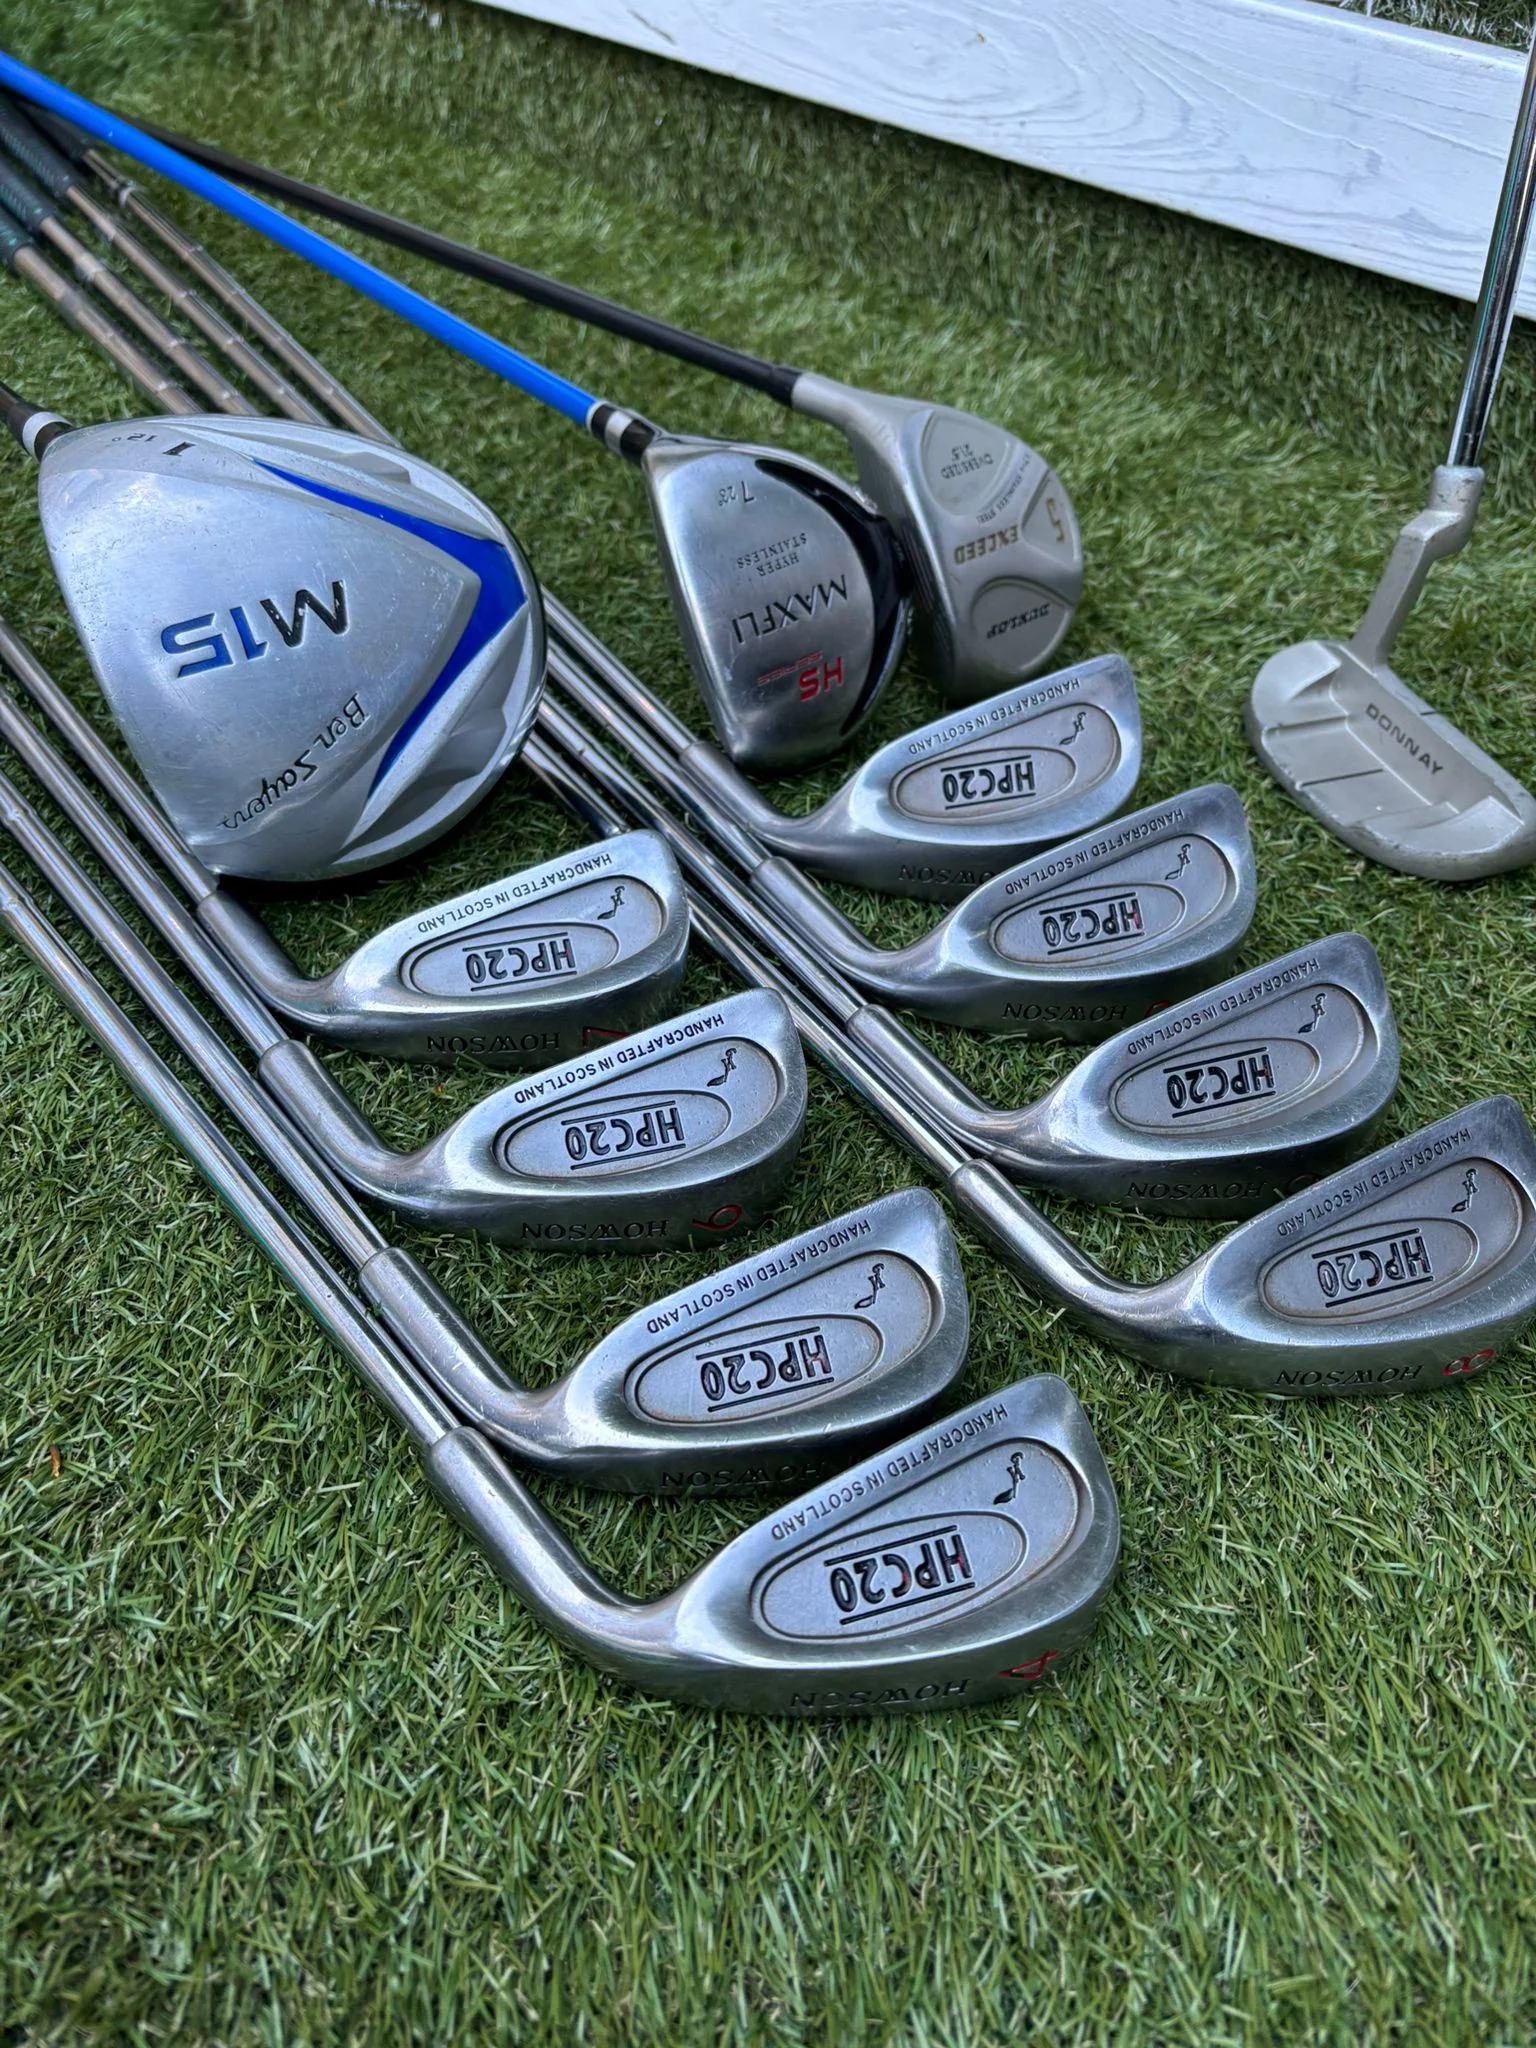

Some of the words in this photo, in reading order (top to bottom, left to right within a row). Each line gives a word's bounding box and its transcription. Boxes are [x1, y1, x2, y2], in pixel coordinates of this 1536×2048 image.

[162, 441, 197, 457] 1
[741, 480, 755, 503] 7
[1046, 498, 1065, 543] 5
[736, 533, 807, 569] STAINLESS
[756, 552, 799, 577] HYPER
[953, 523, 1020, 565] EXCEED
[160, 579, 349, 679] M15
[731, 574, 848, 644] MAXFLI
[986, 603, 1050, 639] DUNLOP
[798, 656, 844, 702] HS
[991, 678, 1081, 721] HANDCRAFTED
[314, 693, 371, 751] Ben
[908, 719, 975, 755] SCOTLAND
[976, 714, 990, 727] IN
[1365, 703, 1444, 775] DONNAY
[217, 749, 320, 829] Sayers
[942, 761, 1036, 802] HPC20
[1092, 808, 1185, 857] HANDCRAFTED
[513, 853, 613, 898] HANDCRAFTED
[1005, 854, 1074, 895] SCOTLAND
[1075, 849, 1090, 864] IN
[417, 895, 494, 933] SCOTLAND
[495, 891, 511, 905] IN
[1042, 899, 1144, 947] HPC20
[466, 938, 576, 984] HPC20
[1220, 958, 1321, 1012] HANDCRAFTED
[1001, 1002, 1128, 1022] HOWSON
[1203, 1003, 1218, 1019] IN
[427, 1033, 560, 1052] HOWSON
[617, 1014, 725, 1063] HANDCRAFTED
[1127, 1012, 1201, 1055] SCOTLAND
[514, 1064, 597, 1104] SCOTLAND
[598, 1058, 615, 1073] IN
[1167, 1054, 1276, 1109] HPC20
[565, 1107, 685, 1161] HPC20
[1372, 1128, 1472, 1187] HANDCRAFTED
[1124, 1181, 1264, 1200] HOWSON
[1353, 1180, 1369, 1196] IN
[520, 1220, 668, 1241] HOWSON
[1277, 1187, 1354, 1236] SCOTLAND
[758, 1219, 872, 1282] HANDCRAFTED
[1317, 1236, 1432, 1298] HPC20
[737, 1274, 754, 1293] IN
[646, 1282, 736, 1335] SCOTLAND
[700, 1334, 833, 1401] HPC20
[1274, 1365, 1424, 1388] HOWSON
[1441, 1349, 1495, 1376] 8
[886, 1404, 1009, 1477] HANDCRAFTED
[660, 1462, 826, 1488] HOWSON
[865, 1470, 884, 1491] IN
[771, 1479, 864, 1542] SCOTLAND
[830, 1534, 973, 1613] HPC20
[789, 1678, 972, 1709] HOWSON
